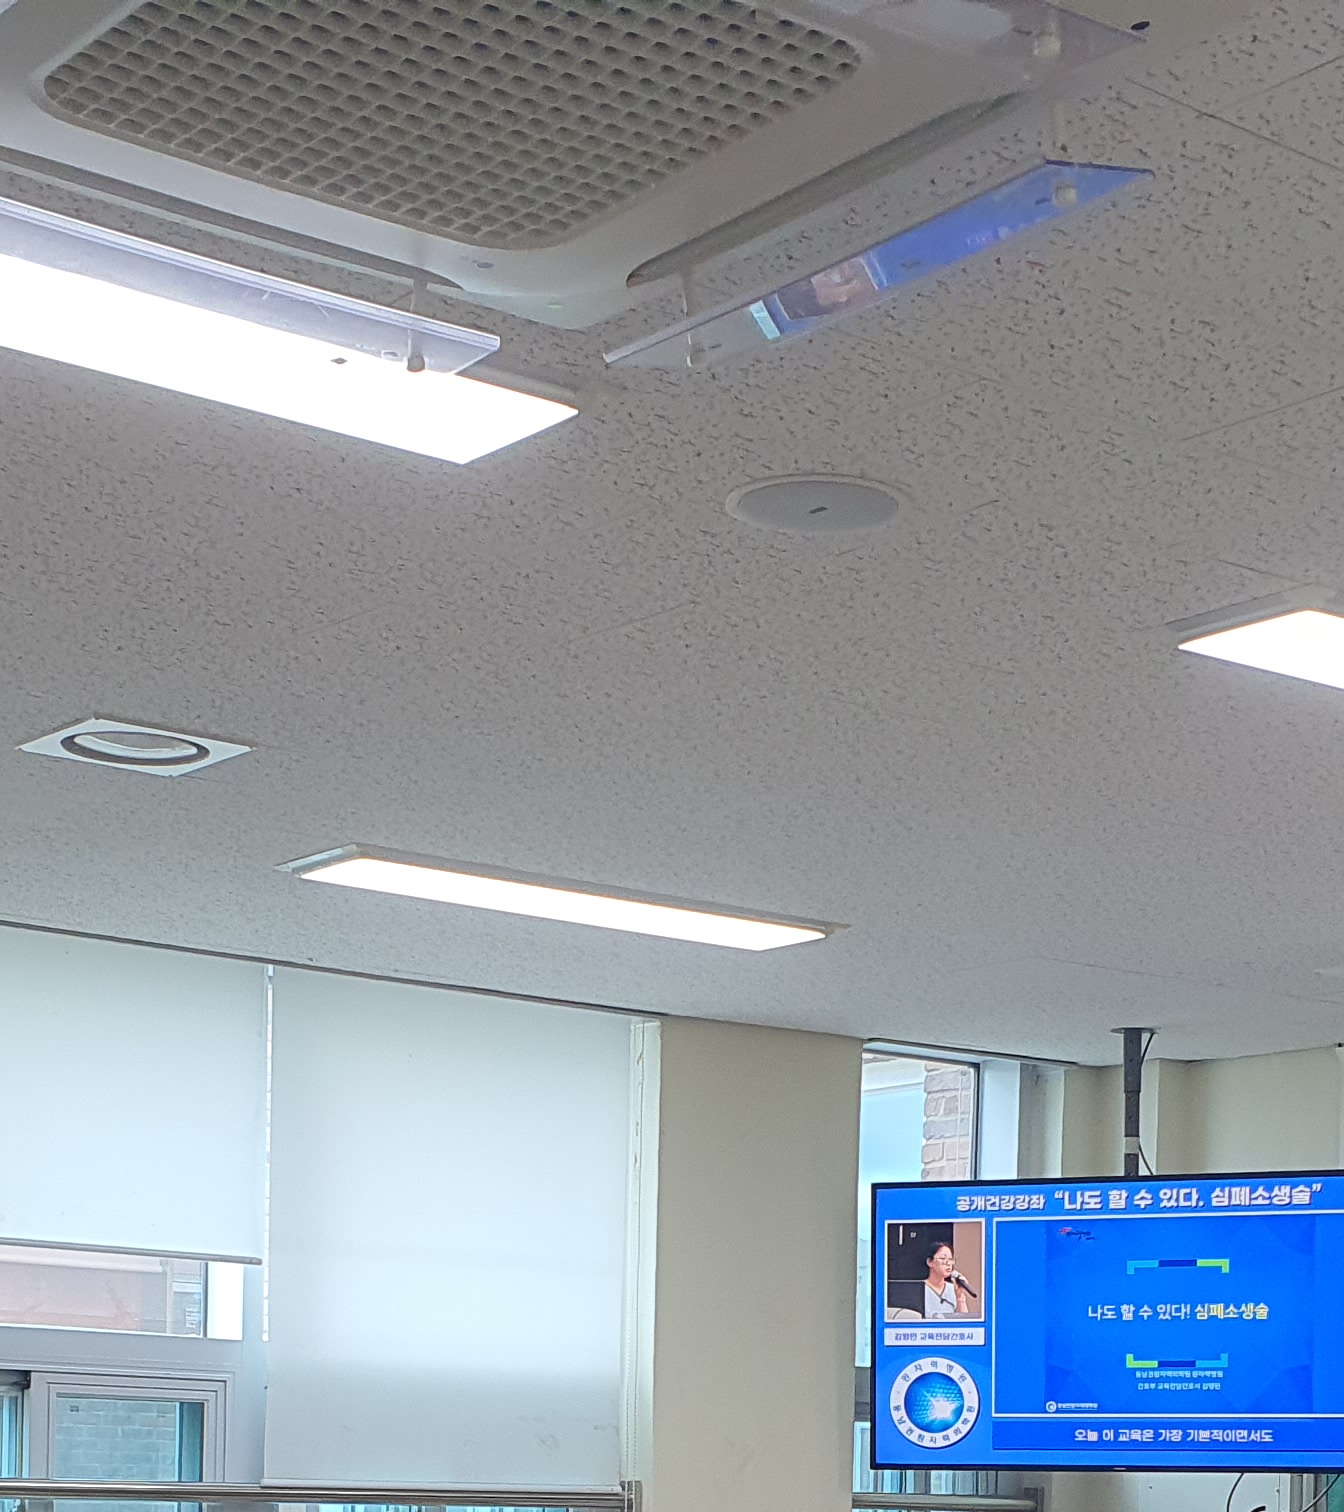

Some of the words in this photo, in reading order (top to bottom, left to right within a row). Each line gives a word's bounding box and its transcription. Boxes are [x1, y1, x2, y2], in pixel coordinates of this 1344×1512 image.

[956, 1195, 1046, 1211] 공개건강강좌
[1108, 1190, 1128, 1210] 할
[1133, 1189, 1153, 1209] 수
[1159, 1187, 1205, 1208] 있다.
[1088, 1304, 1117, 1321] 나도
[1120, 1304, 1135, 1321] 할
[1138, 1304, 1153, 1320] 수
[1156, 1303, 1190, 1320] 있다!
[1194, 1302, 1269, 1320] 심폐소생술
[1074, 1429, 1098, 1442] 오늘
[1102, 1429, 1114, 1442] 이
[1118, 1429, 1154, 1442] 교육은
[1158, 1429, 1182, 1442] 가장
[1186, 1429, 1274, 1442] 기본적이면서도
